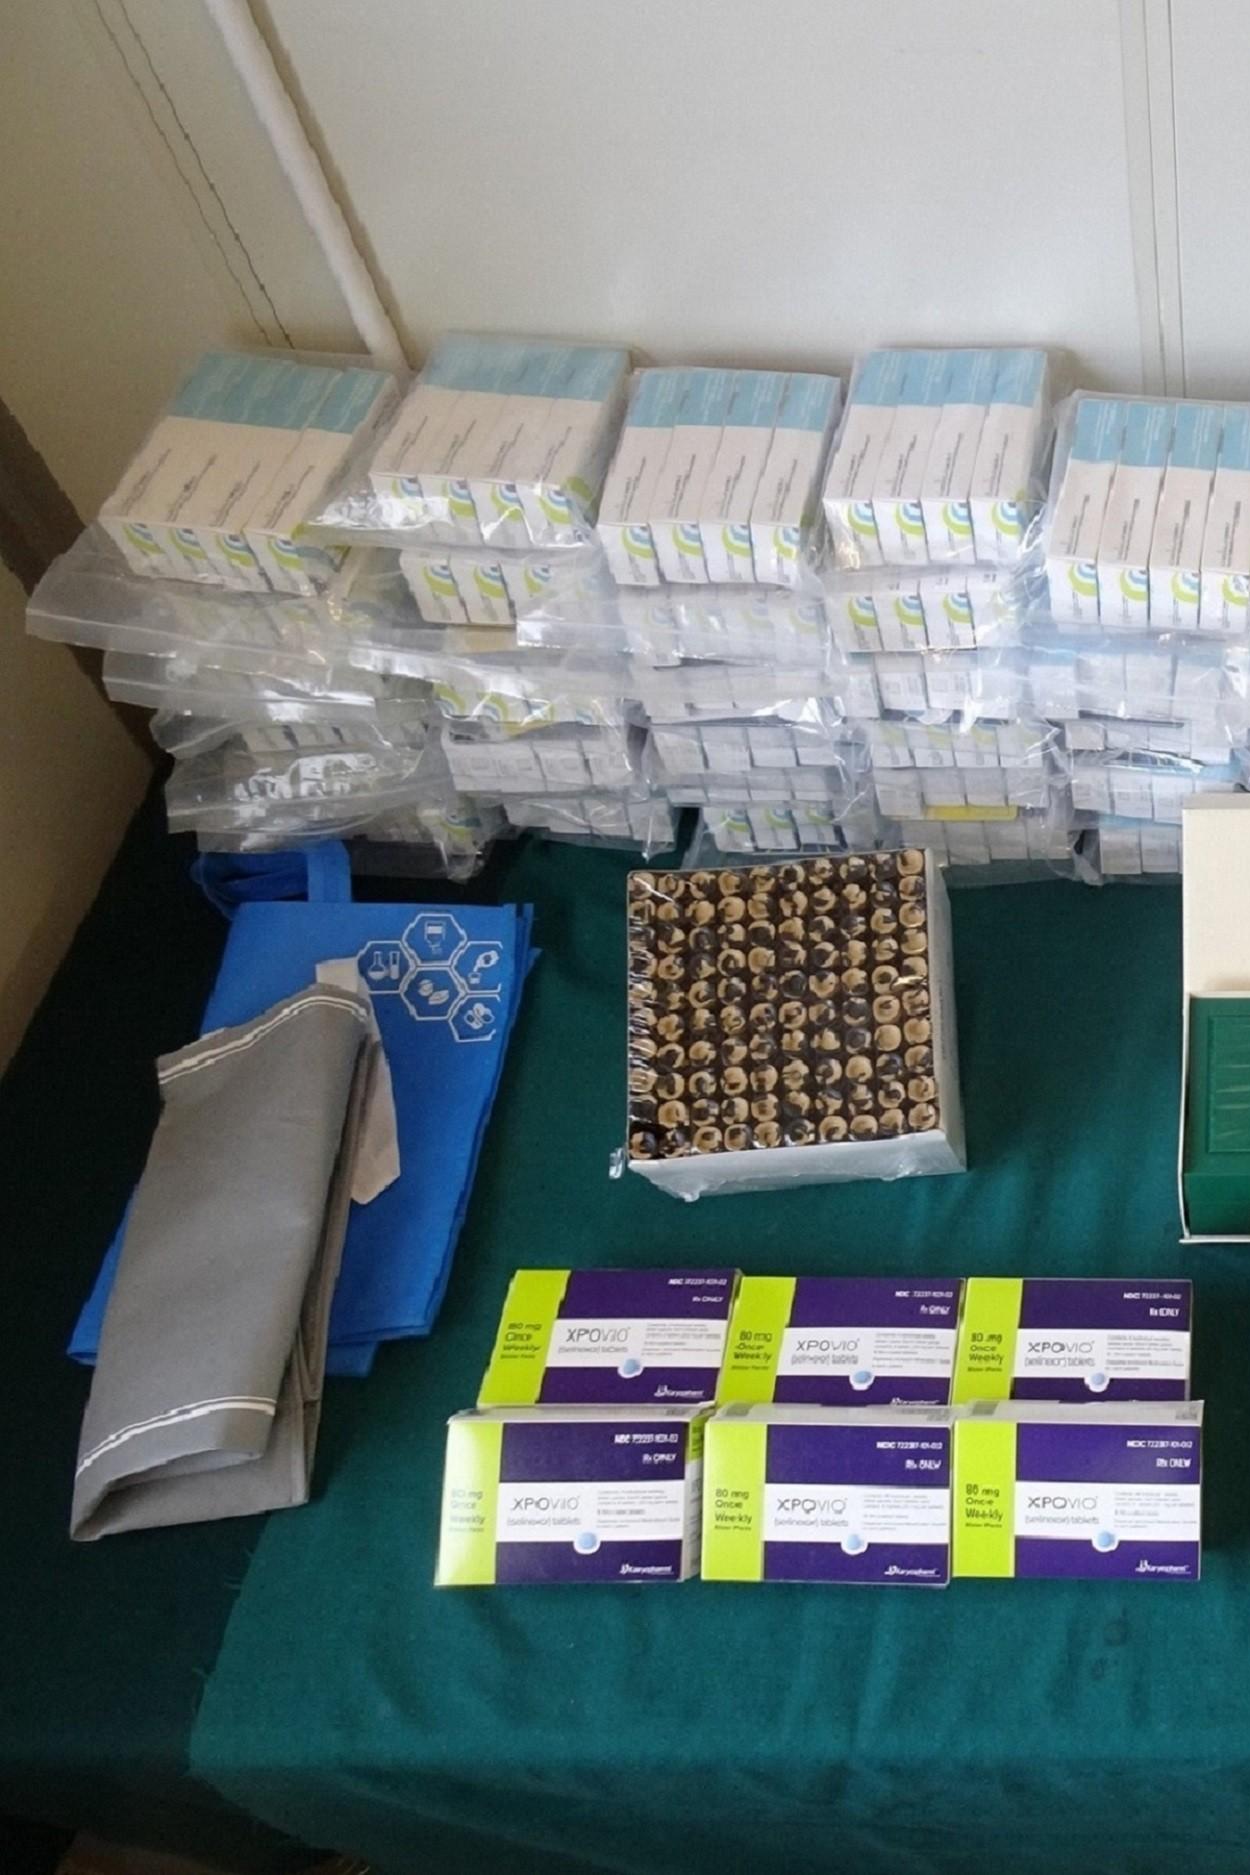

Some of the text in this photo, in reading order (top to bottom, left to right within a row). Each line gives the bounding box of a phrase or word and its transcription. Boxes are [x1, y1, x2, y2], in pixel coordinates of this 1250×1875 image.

[566, 1328, 628, 1343] XPOVIO
[796, 1340, 858, 1351] XPOVIO
[1028, 1341, 1093, 1353] XPOVIO
[969, 1353, 1004, 1365] Weekly
[715, 1489, 728, 1498] 80
[965, 1484, 979, 1496] 80
[512, 1497, 579, 1511] XPOVIO
[714, 1499, 743, 1510] Once
[777, 1498, 846, 1513] XPOVIO
[965, 1497, 994, 1506] Once
[1027, 1496, 1096, 1509] XPOVIO
[714, 1513, 752, 1525] Weekly
[965, 1508, 1003, 1521] Weekly
